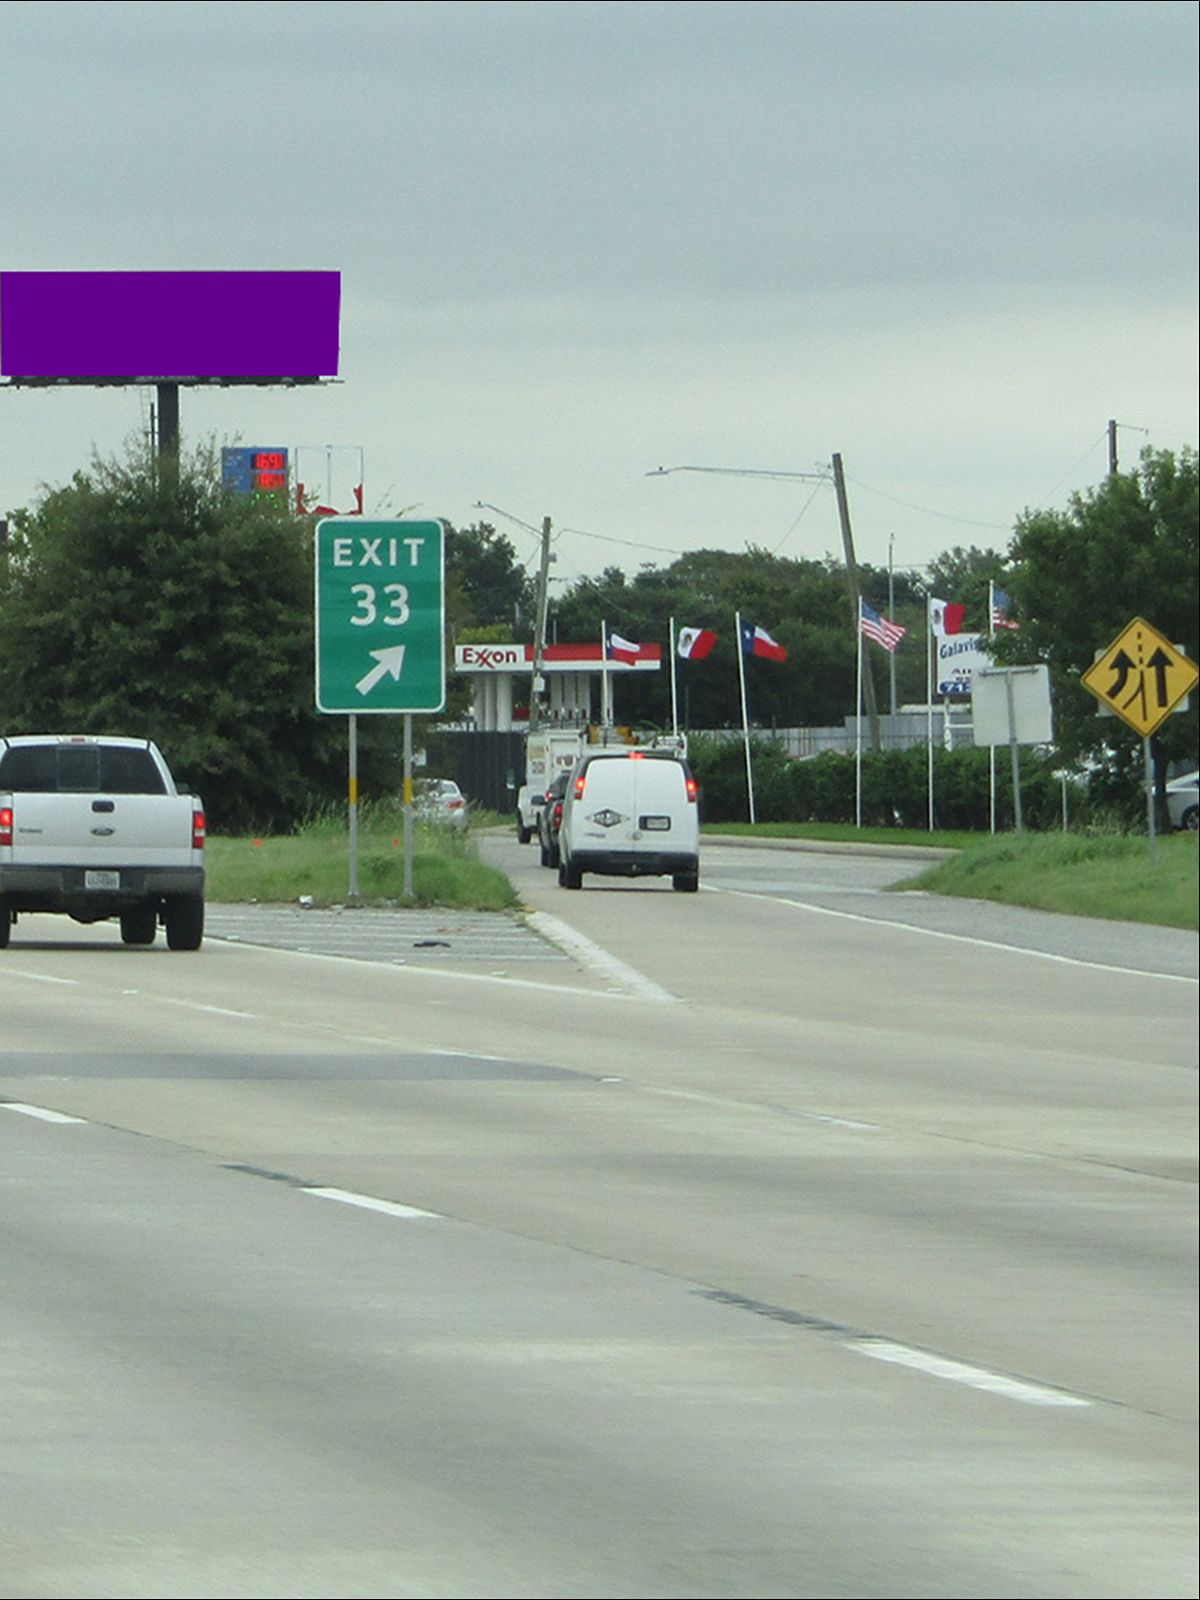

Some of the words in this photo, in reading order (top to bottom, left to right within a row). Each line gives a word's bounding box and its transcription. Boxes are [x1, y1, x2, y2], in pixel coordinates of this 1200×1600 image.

[332, 537, 425, 567] EXIT
[350, 583, 411, 627] 33
[462, 647, 517, 669] Exxon
